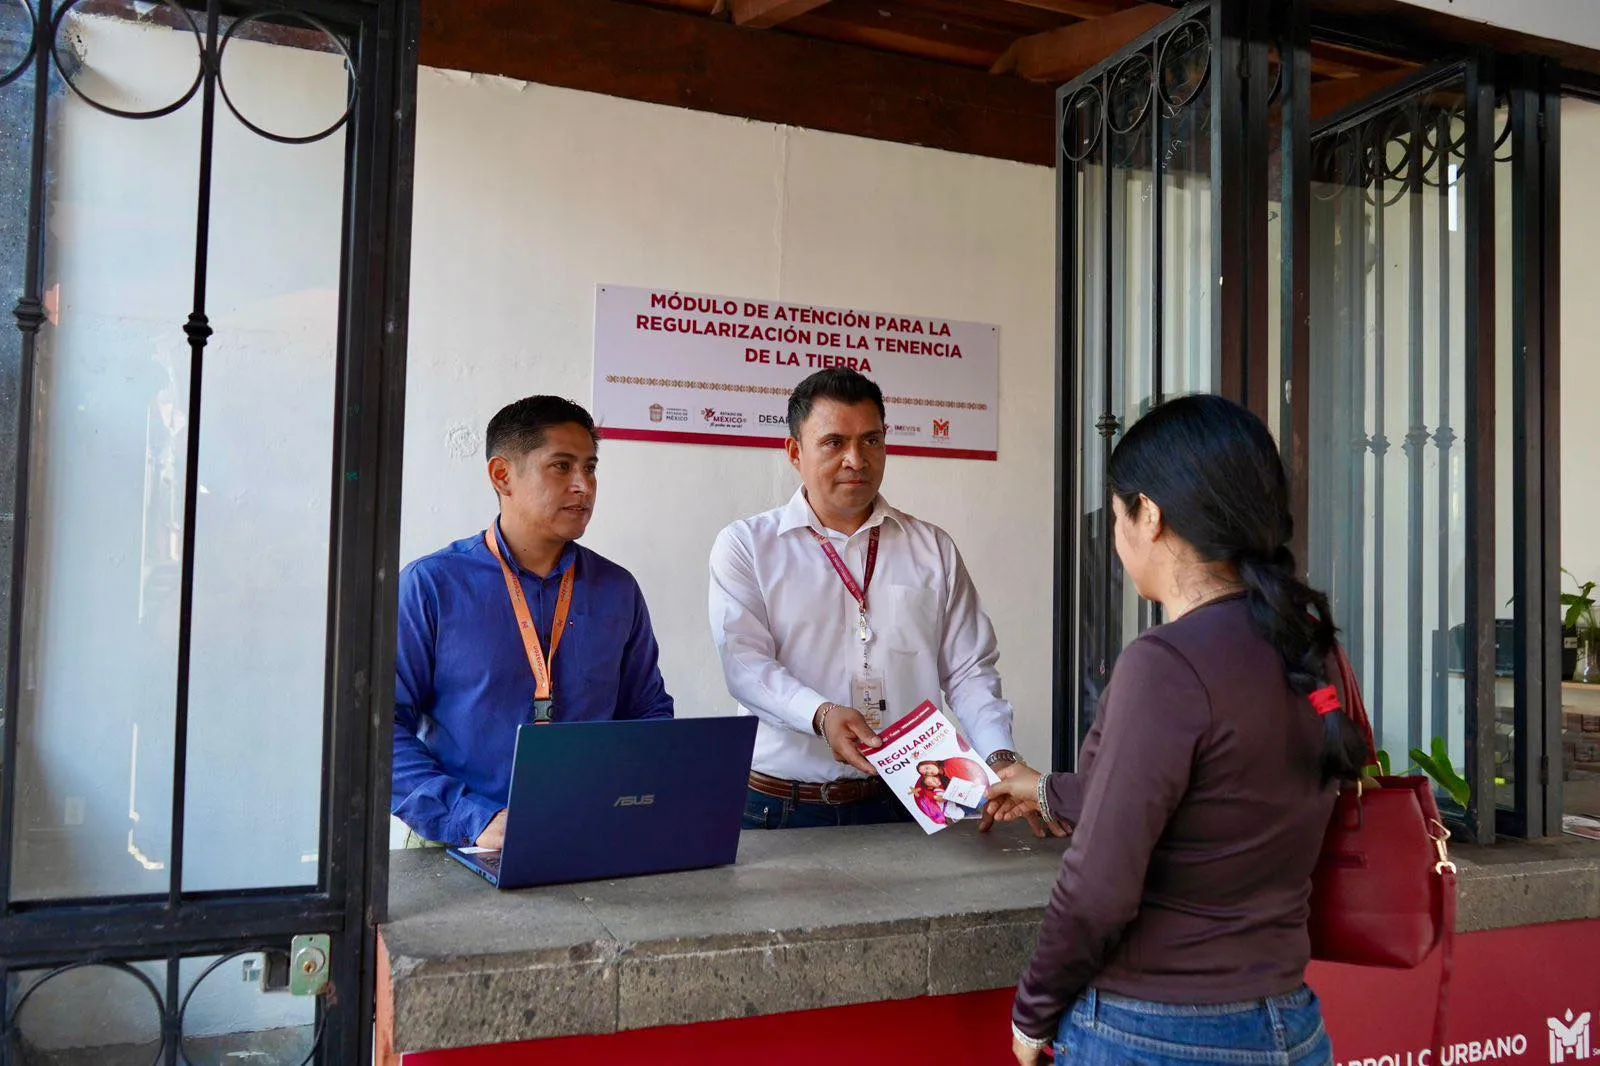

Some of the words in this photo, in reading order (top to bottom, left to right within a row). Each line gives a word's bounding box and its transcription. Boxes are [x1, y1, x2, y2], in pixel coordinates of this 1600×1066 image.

[651, 292, 738, 316] MÓDULO
[743, 302, 769, 319] DE
[774, 306, 870, 329] ATENCIÓN
[875, 316, 924, 334] PARA
[929, 321, 951, 337] LA
[636, 314, 811, 344] REGULARIZACIÓN
[816, 331, 841, 347] DE
[846, 334, 869, 350] LA
[875, 337, 962, 359] TENENCIA
[745, 348, 770, 364] DE
[776, 351, 800, 366] LA
[806, 353, 872, 372] TIERRA
[713, 416, 742, 424] MÉXICO
[877, 721, 944, 768] REGULARIZA
[884, 757, 911, 776] CON
[613, 794, 655, 807] ASUS
[1336, 1048, 1432, 1066] OLLO
[1440, 1034, 1528, 1066] URBANO
